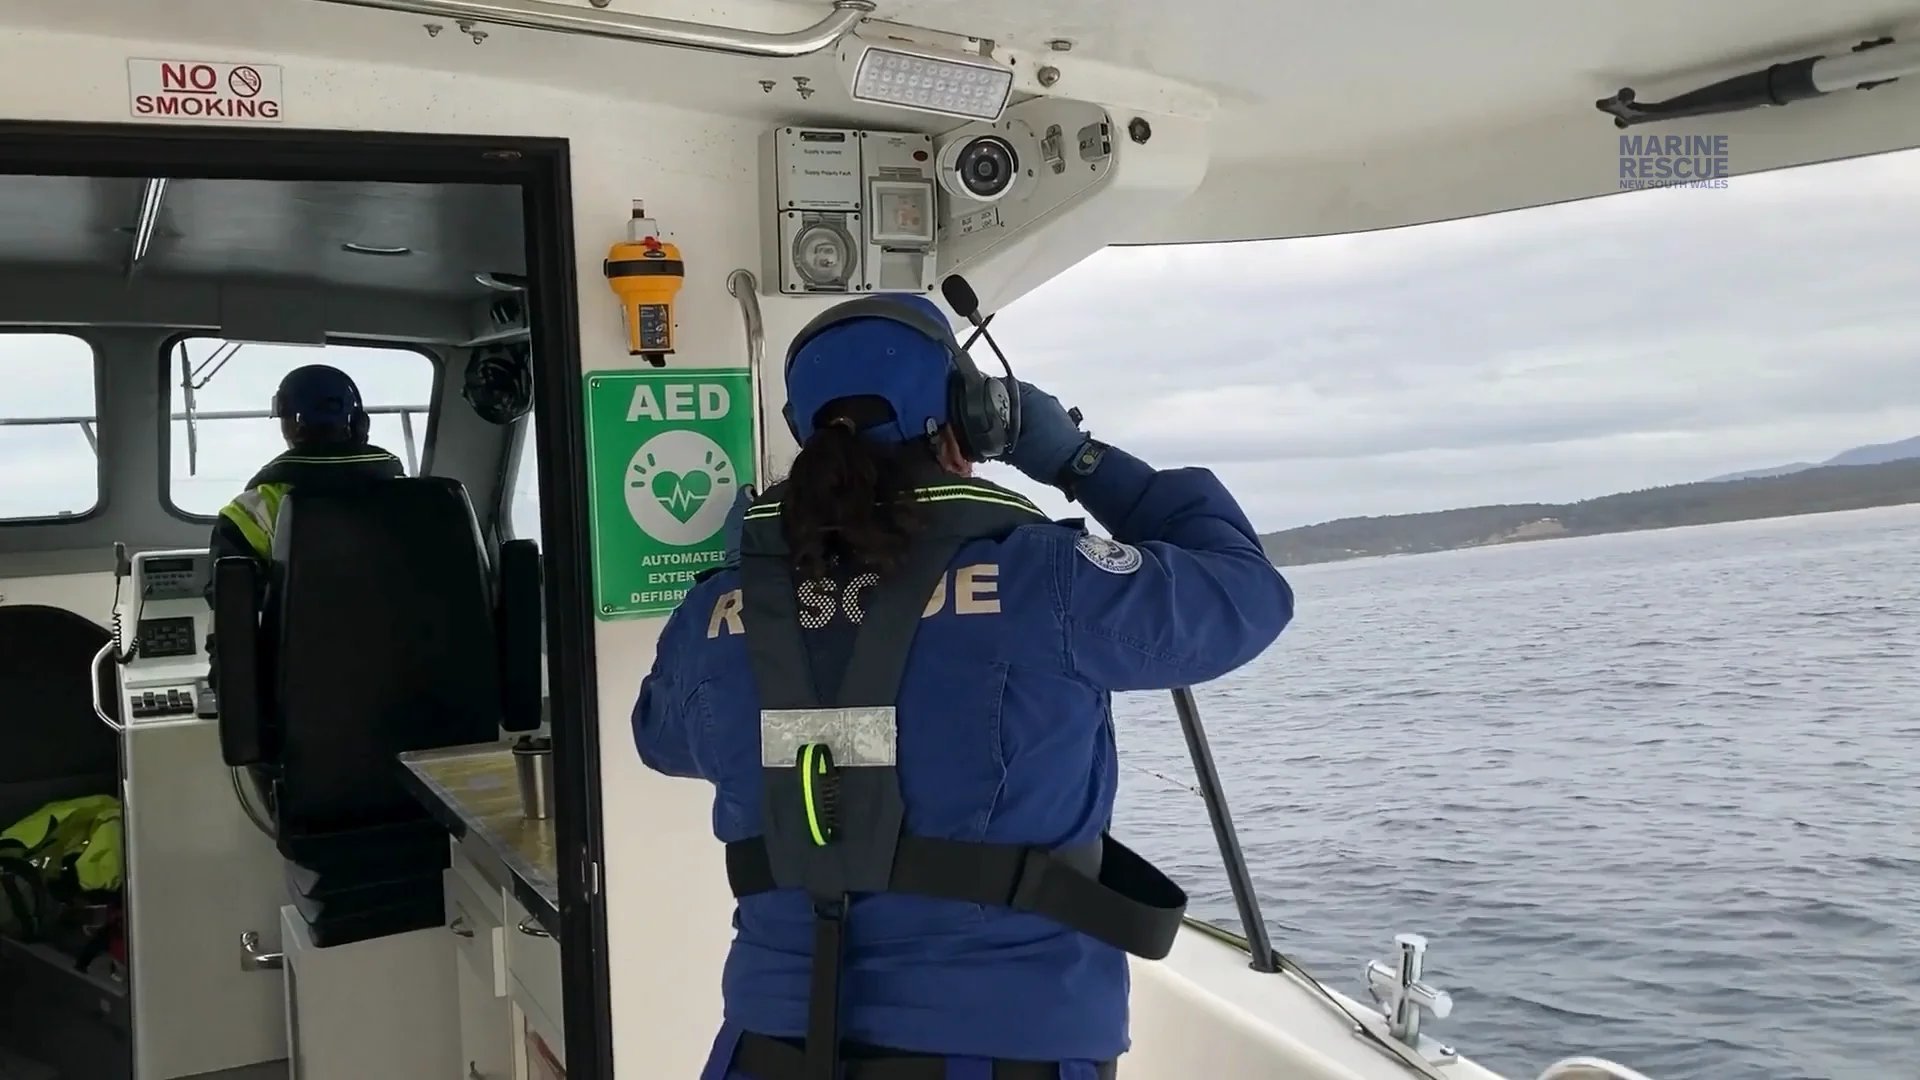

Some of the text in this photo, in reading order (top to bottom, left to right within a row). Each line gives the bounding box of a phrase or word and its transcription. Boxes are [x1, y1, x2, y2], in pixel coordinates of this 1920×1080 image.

[162, 63, 217, 90] NO
[135, 95, 279, 119] SMOKING
[626, 384, 731, 422] AED
[641, 550, 727, 567] AUTOMATED
[648, 570, 700, 584] EXTER
[631, 589, 689, 603] DEFIBRI
